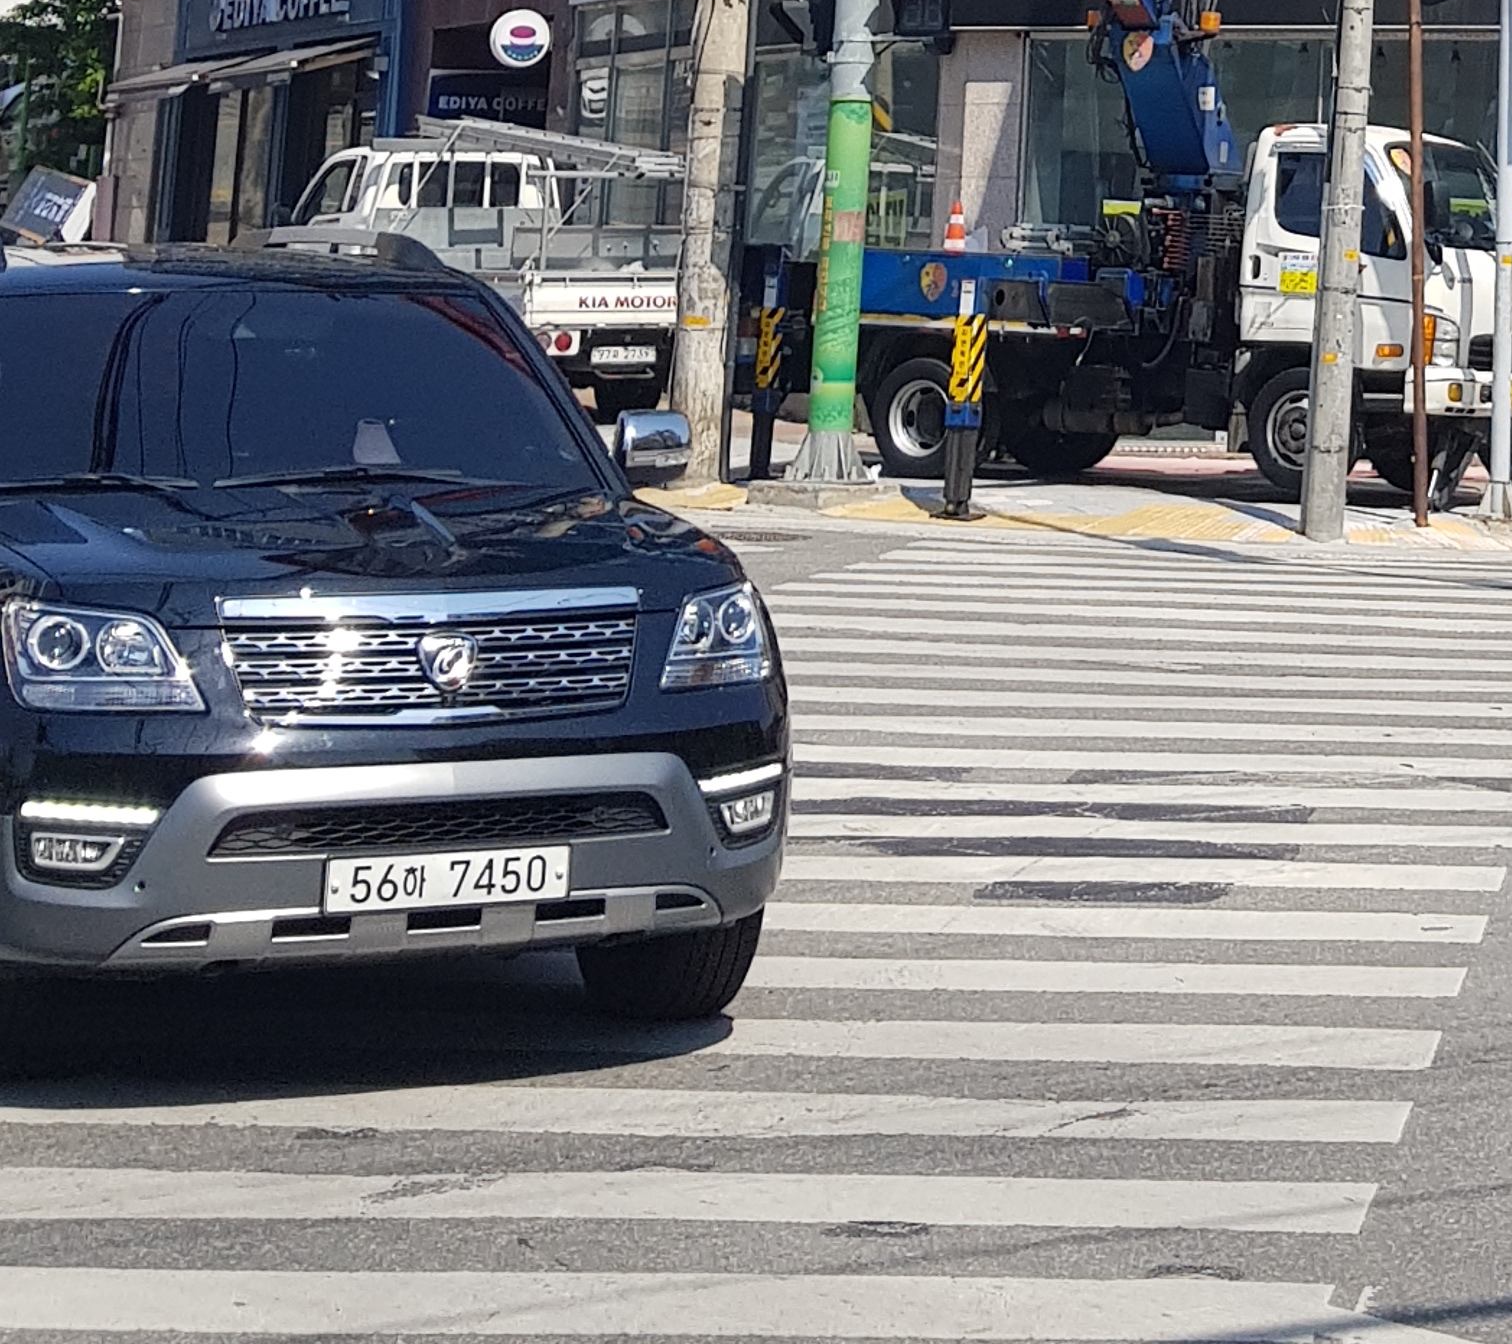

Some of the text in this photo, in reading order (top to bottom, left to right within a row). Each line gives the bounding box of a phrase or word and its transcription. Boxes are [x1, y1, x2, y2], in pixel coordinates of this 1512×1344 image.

[438, 95, 488, 110] EDIYA
[578, 295, 677, 309] KIA MOTOR
[349, 854, 547, 904] 56하 7450
